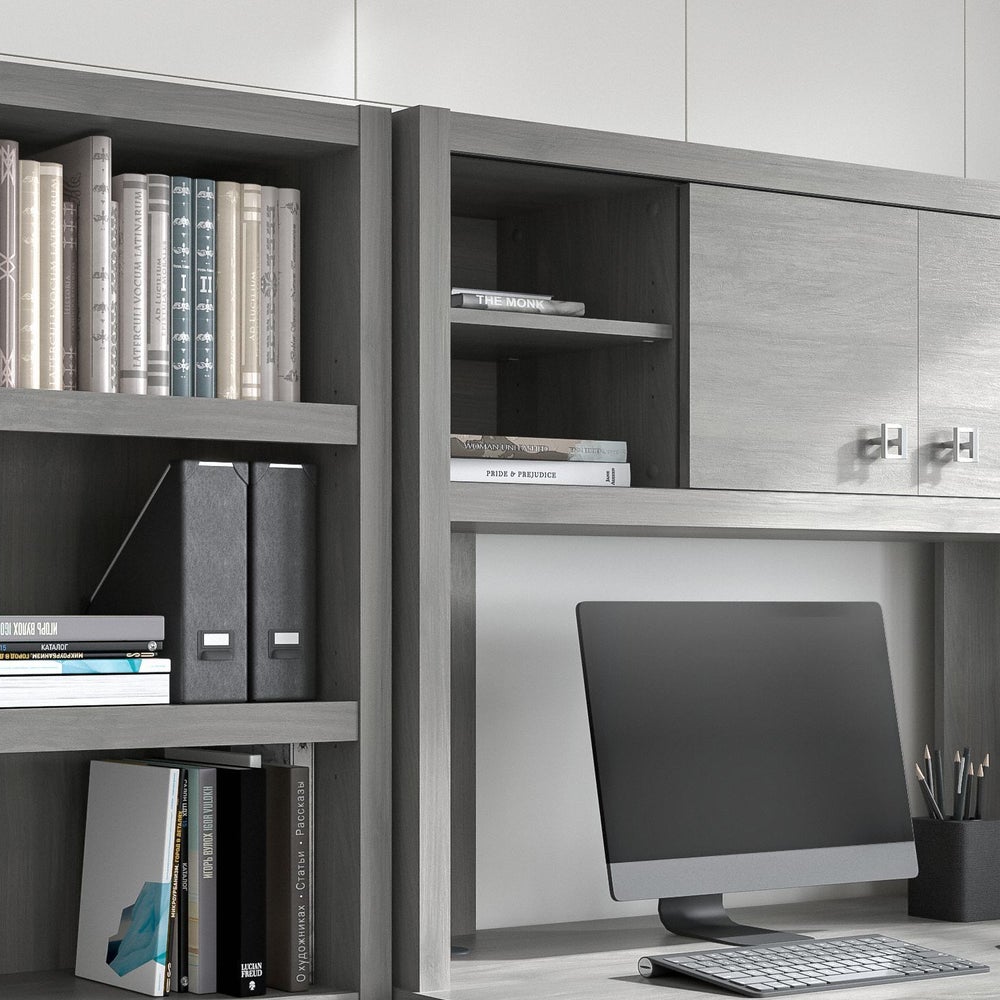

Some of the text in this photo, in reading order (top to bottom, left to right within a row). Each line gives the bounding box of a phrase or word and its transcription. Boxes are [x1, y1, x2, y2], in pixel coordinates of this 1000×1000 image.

[134, 191, 142, 257] LATINARUM
[134, 262, 142, 304] VOCUM
[199, 276, 213, 293] II
[476, 294, 545, 310] THE MONK
[486, 470, 557, 479] PRIDE & PREJUDICE
[12, 621, 35, 636] ВУЛОХ
[37, 621, 58, 636] ИГОРЬ
[40, 643, 69, 652] КАТАЛОГ
[202, 786, 213, 879] ИГОРЬ ВУЛОХ IGOR VULOKH
[295, 781, 309, 982] О художниках Статьи Рассказы
[241, 962, 262, 970] LUCIAN
[241, 969, 262, 978] FREUD
